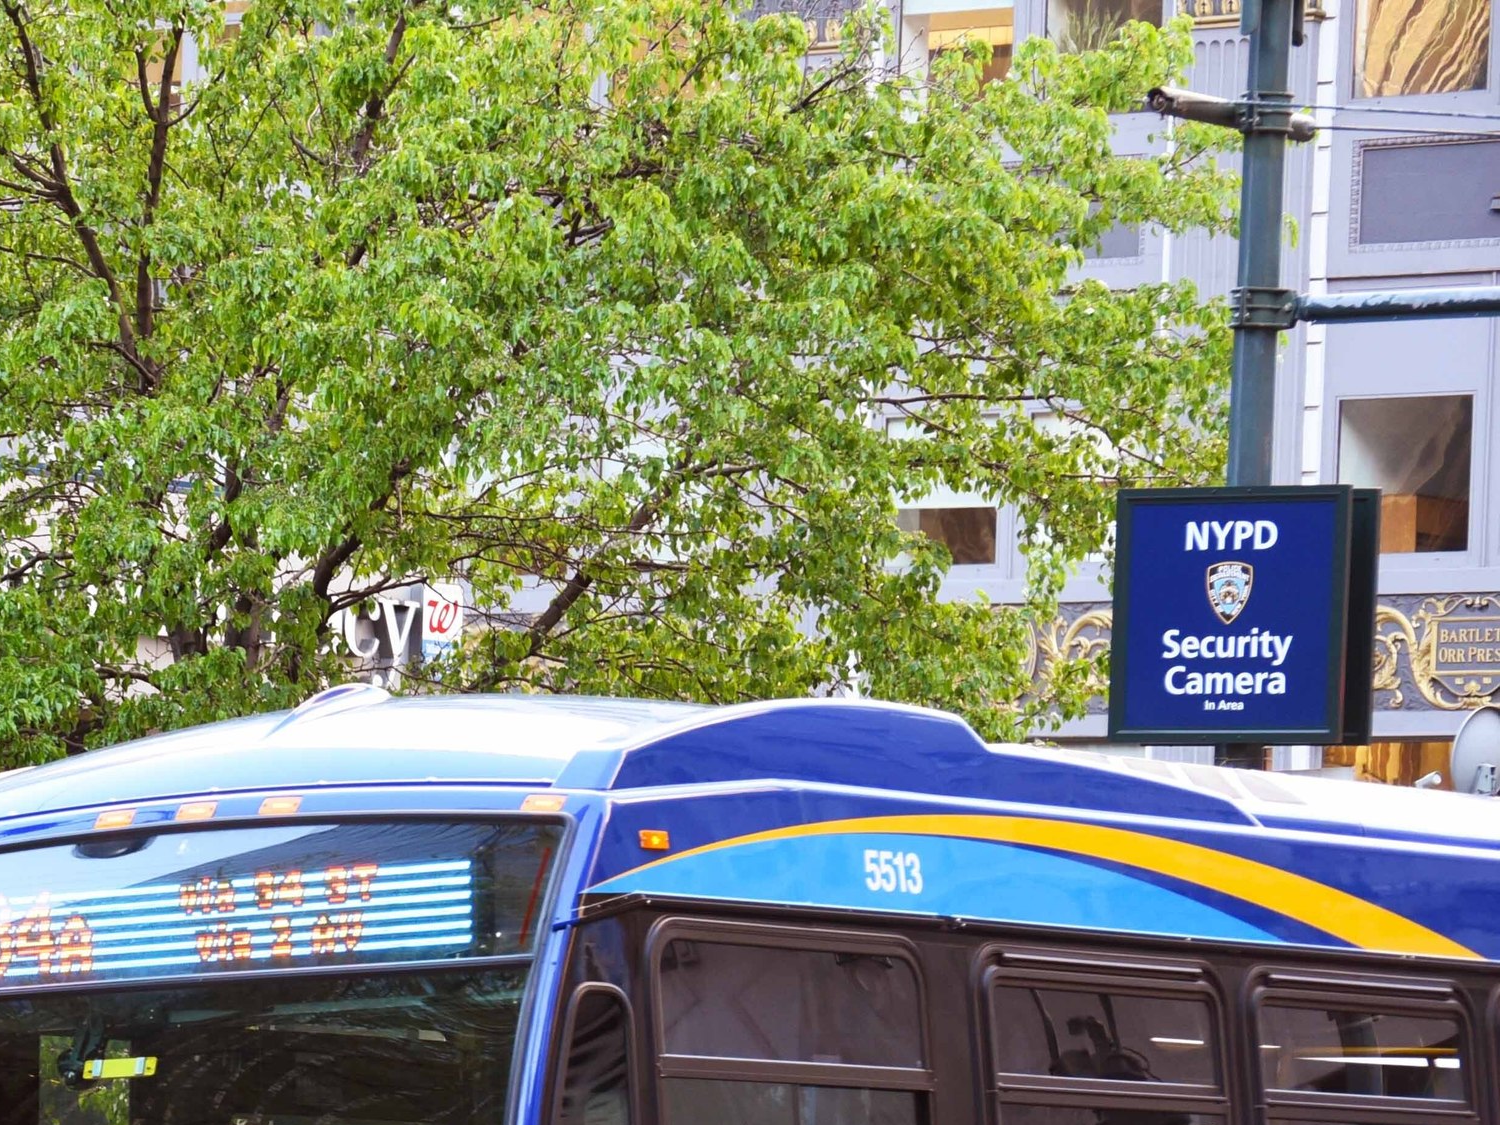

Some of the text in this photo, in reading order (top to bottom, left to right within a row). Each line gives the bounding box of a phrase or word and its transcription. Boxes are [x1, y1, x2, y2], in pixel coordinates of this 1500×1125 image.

[1185, 520, 1278, 551] NYPD
[1161, 627, 1293, 666] Security
[1438, 646, 1466, 663] ORR
[1164, 665, 1286, 695] Camera
[1204, 699, 1244, 711] In Area
[863, 848, 924, 895] 5513
[195, 911, 363, 961] via 2 AV
